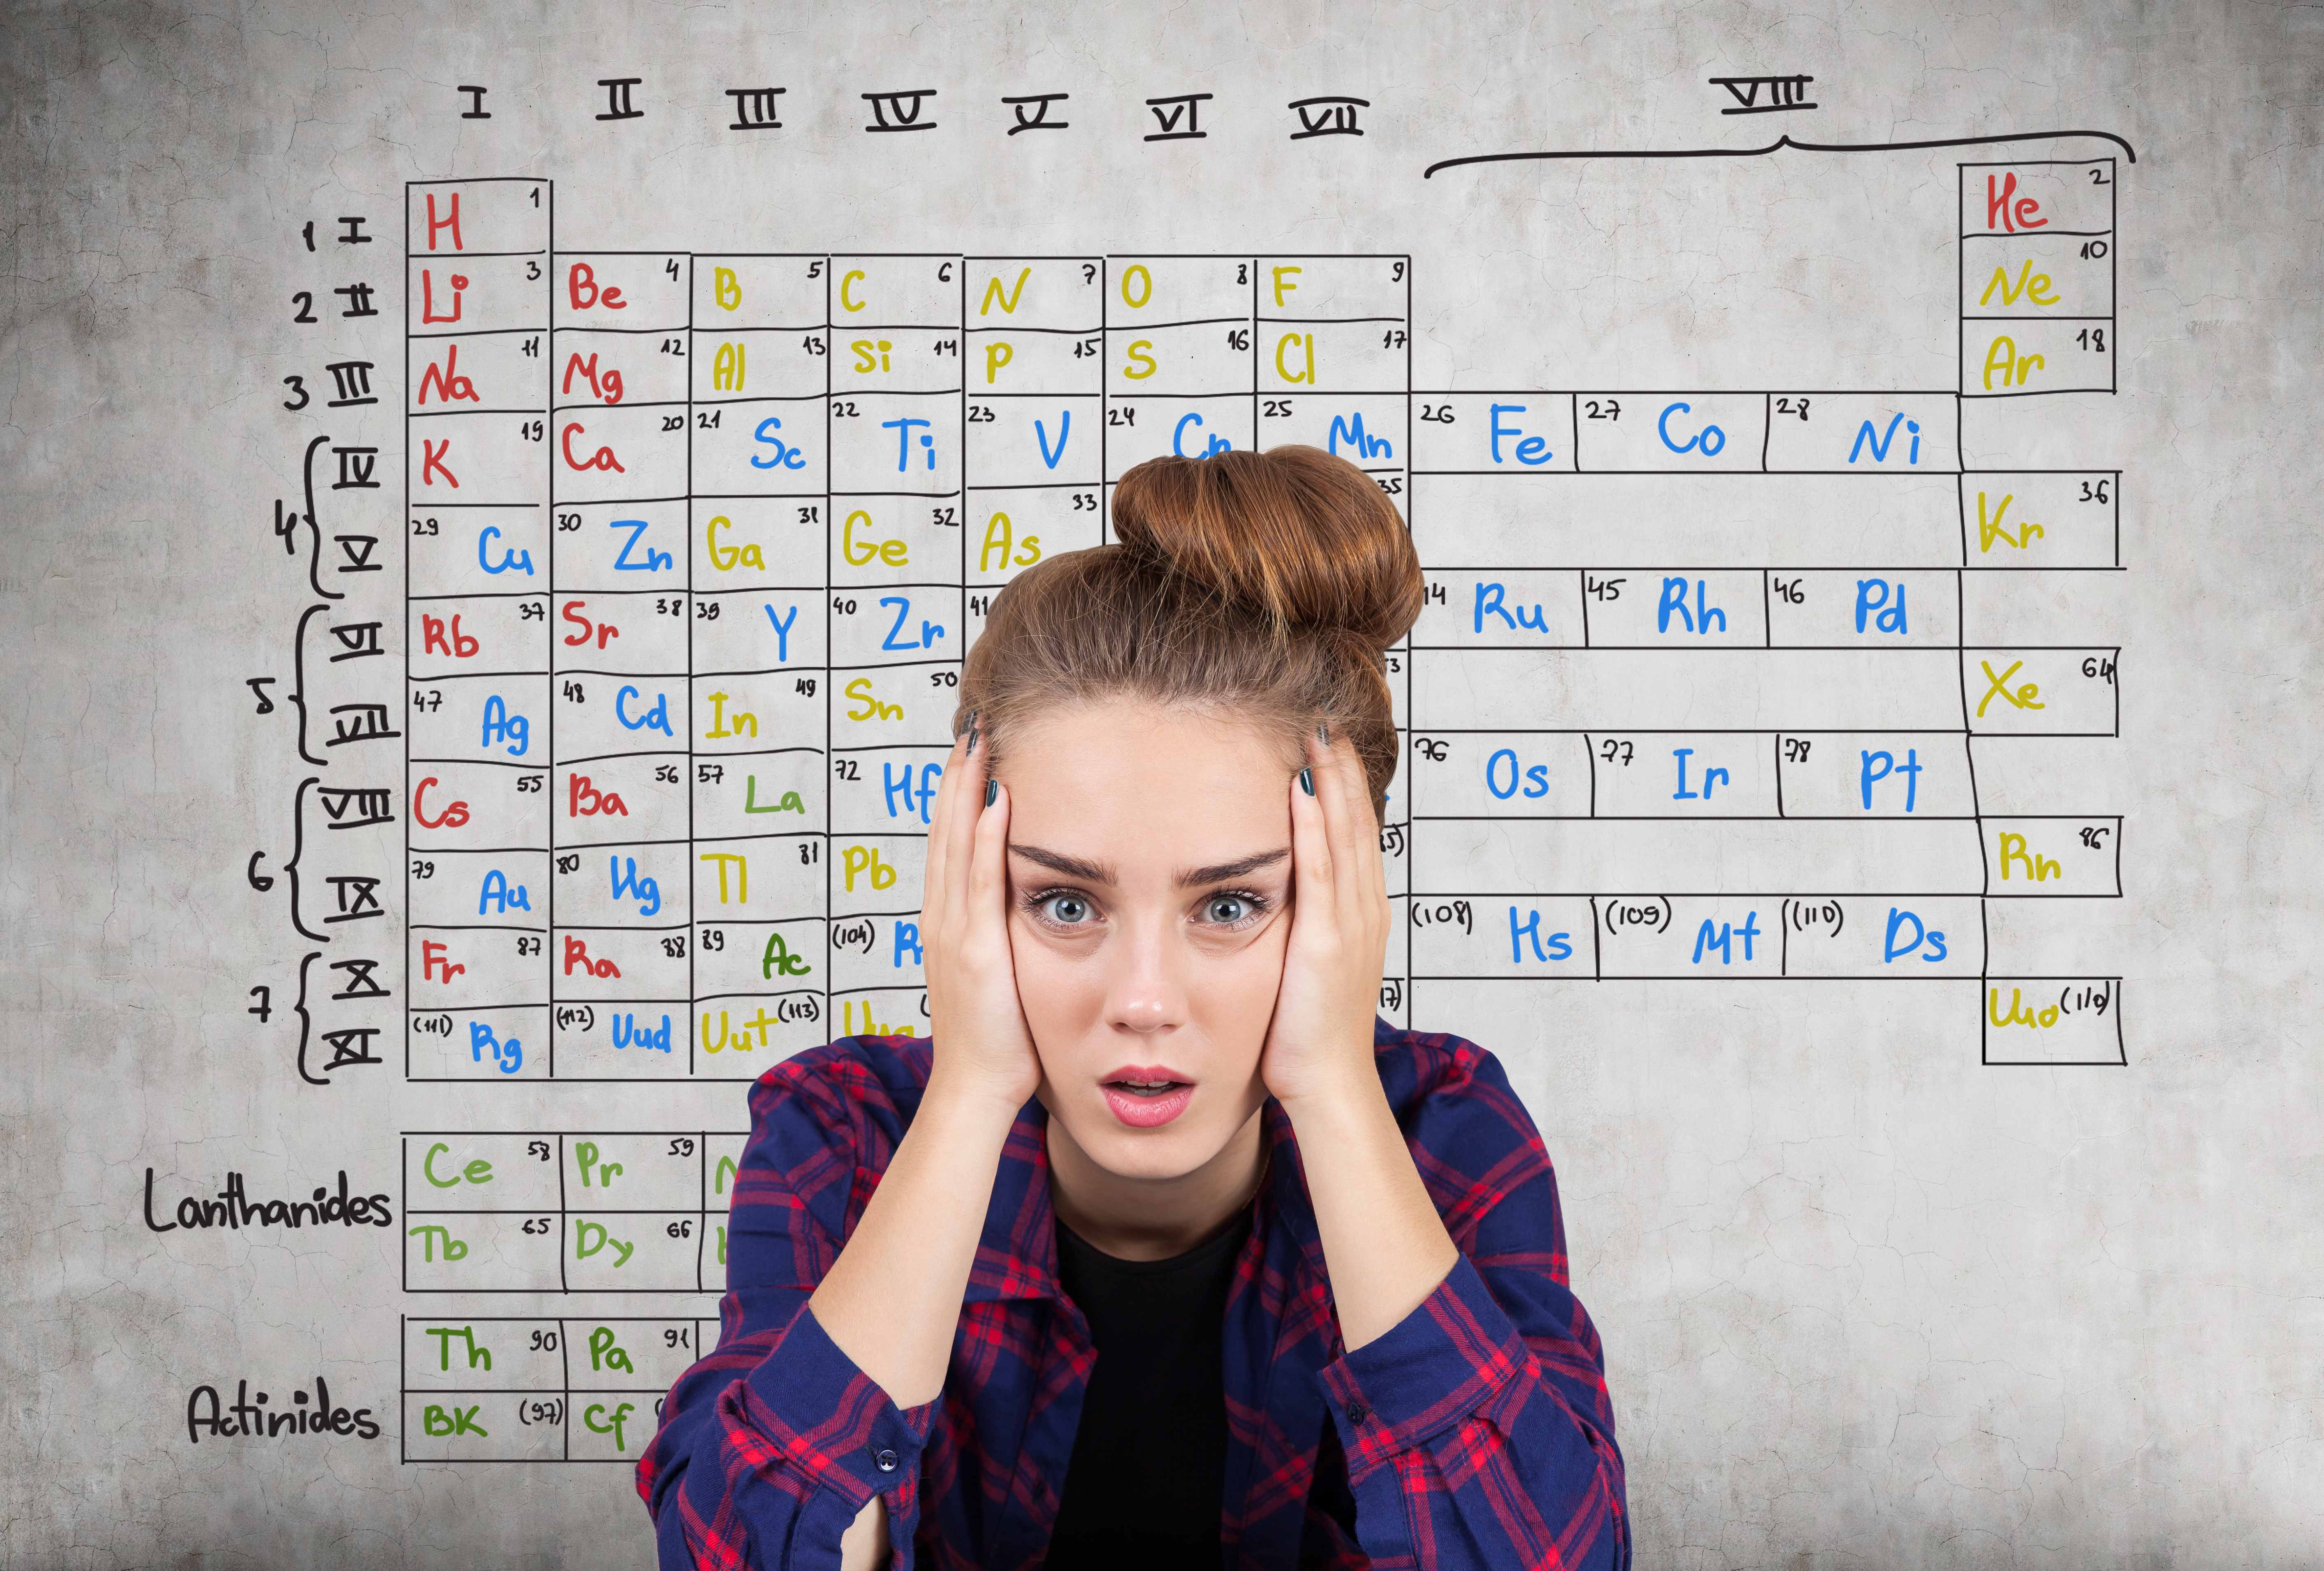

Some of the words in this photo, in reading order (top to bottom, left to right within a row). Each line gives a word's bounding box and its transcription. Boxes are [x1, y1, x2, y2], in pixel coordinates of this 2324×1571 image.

[458, 86, 491, 118] I
[596, 78, 644, 120] II
[726, 88, 786, 129] III
[861, 90, 937, 131] IV
[1002, 94, 1068, 135] V
[1144, 94, 1213, 141] VI
[1289, 97, 1369, 139] VII
[1709, 75, 1817, 114] VIII
[427, 193, 463, 250] H
[530, 188, 538, 207] 1
[1988, 173, 2048, 233] He
[2089, 170, 2110, 184] 2
[423, 270, 468, 324] Li
[527, 262, 541, 280] 3
[569, 263, 626, 309] Be
[666, 259, 678, 281] 4
[714, 267, 742, 311] B
[808, 262, 822, 278] 5
[841, 270, 866, 312] C
[939, 263, 951, 281] 6
[980, 267, 1031, 316] N
[1083, 265, 1095, 284] 7
[1122, 265, 1152, 308] O
[1237, 265, 1246, 284] 8
[1272, 266, 1301, 307] F
[1392, 263, 1403, 281] 9
[1980, 259, 2060, 306] Ne
[2081, 241, 2107, 259] 10
[293, 292, 317, 322] 2
[419, 344, 479, 405] Na
[522, 336, 538, 357] 11
[563, 353, 623, 405] Mg
[661, 339, 684, 355] 12
[713, 342, 745, 392] Al
[804, 336, 825, 355] 13
[934, 341, 956, 356] 14
[986, 342, 1013, 384] P
[1075, 339, 1101, 358] 15
[1124, 340, 1157, 380] S
[1228, 330, 1248, 350] 16
[1276, 333, 1315, 385] Cl
[1384, 331, 1407, 348] 17
[1983, 336, 2044, 391] Ar
[2077, 329, 2105, 352] 18
[284, 376, 309, 410] 3
[326, 362, 378, 407] III
[1264, 401, 1292, 416] 25
[698, 410, 720, 428] 21
[751, 417, 806, 470] Sc
[833, 403, 859, 417] 22
[882, 418, 935, 472] Ti
[969, 407, 995, 422] 23
[1035, 410, 1070, 469] V
[1109, 408, 1134, 426] 24
[1490, 403, 1553, 465] Fe
[1586, 401, 1620, 421] 27
[1658, 403, 1725, 456] Co
[1777, 399, 1809, 420] 28
[1848, 412, 1919, 465] Ni
[332, 448, 380, 489] IV
[424, 439, 458, 488] K
[522, 421, 542, 441] 19
[562, 423, 624, 473] Ca
[662, 416, 683, 431] 20
[276, 500, 297, 555] 4
[707, 516, 765, 571] Ga
[798, 507, 818, 523] 31
[843, 510, 908, 567] Ge
[933, 508, 959, 526] 32
[980, 512, 1041, 572] As
[1073, 494, 1096, 510] 33
[1978, 492, 2044, 553] Kr
[2080, 480, 2109, 504] 36
[334, 536, 382, 572] V
[412, 519, 438, 535] 29
[479, 526, 534, 576] Cu
[559, 514, 581, 531] 30
[610, 520, 673, 572] Zn
[423, 614, 479, 657] Rb
[520, 603, 544, 621] 37
[562, 601, 619, 649] Sr
[657, 599, 682, 616] 38
[834, 597, 856, 614] 40
[880, 597, 945, 651] Zr
[1474, 583, 1549, 633] Ru
[1589, 577, 1626, 601] 45
[1658, 577, 1726, 634] Rh
[1775, 578, 1803, 603] 46
[1856, 578, 1907, 634] Pd
[330, 622, 384, 662] VI
[697, 603, 719, 620] 39
[765, 604, 797, 662] Y
[246, 678, 275, 714] 5
[564, 681, 584, 703] 48
[616, 686, 673, 736] Cd
[705, 691, 758, 739] In
[796, 679, 815, 697] 49
[845, 678, 903, 721] Sn
[931, 673, 957, 686] 50
[1977, 661, 2045, 718] Xe
[326, 705, 401, 746] VII
[414, 691, 442, 712] 47
[482, 695, 529, 756] Ag
[836, 760, 860, 780] 72
[1415, 738, 1449, 761] 76
[1486, 749, 1549, 799] Os
[1673, 749, 1729, 799] Ir
[1785, 739, 1810, 762] 78
[318, 787, 395, 829] VIII
[414, 777, 470, 828] Cs
[518, 776, 544, 792] 55
[570, 774, 628, 817] Ba
[656, 765, 678, 783] 56
[699, 765, 723, 784] 57
[746, 776, 804, 813] La
[249, 851, 273, 891] 6
[556, 855, 579, 874] 80
[799, 842, 817, 864] 81
[842, 845, 896, 892] Pb
[1999, 832, 2061, 881] Rn
[2080, 828, 2109, 849] 86
[324, 877, 384, 923] IX
[412, 861, 434, 879] 79
[479, 870, 531, 915] Au
[565, 935, 621, 978] Ra
[703, 930, 723, 951] 89
[763, 934, 810, 979] Ac
[1509, 906, 1573, 963] Hs
[1692, 911, 1760, 965] Mt
[1884, 907, 1947, 963] Ds
[330, 960, 390, 1000] X
[423, 940, 465, 984] Fr
[518, 938, 540, 956] 87
[249, 986, 271, 1023] 7
[322, 1029, 382, 1071] XI
[469, 1021, 523, 1073] Rg
[425, 1144, 493, 1187] Ce
[529, 1141, 549, 1161] 58
[577, 1143, 622, 1186] Pr
[668, 1138, 693, 1156] 59
[145, 1168, 392, 1232] Lanthanides
[410, 1226, 467, 1262] Tb
[522, 1219, 550, 1234] 65
[577, 1220, 633, 1267] Dy
[668, 1221, 692, 1237] 66
[427, 1326, 491, 1370] Th
[530, 1331, 556, 1351] 90
[590, 1328, 633, 1373] Pa
[665, 1329, 689, 1348] 91
[188, 1377, 380, 1443] Actinides
